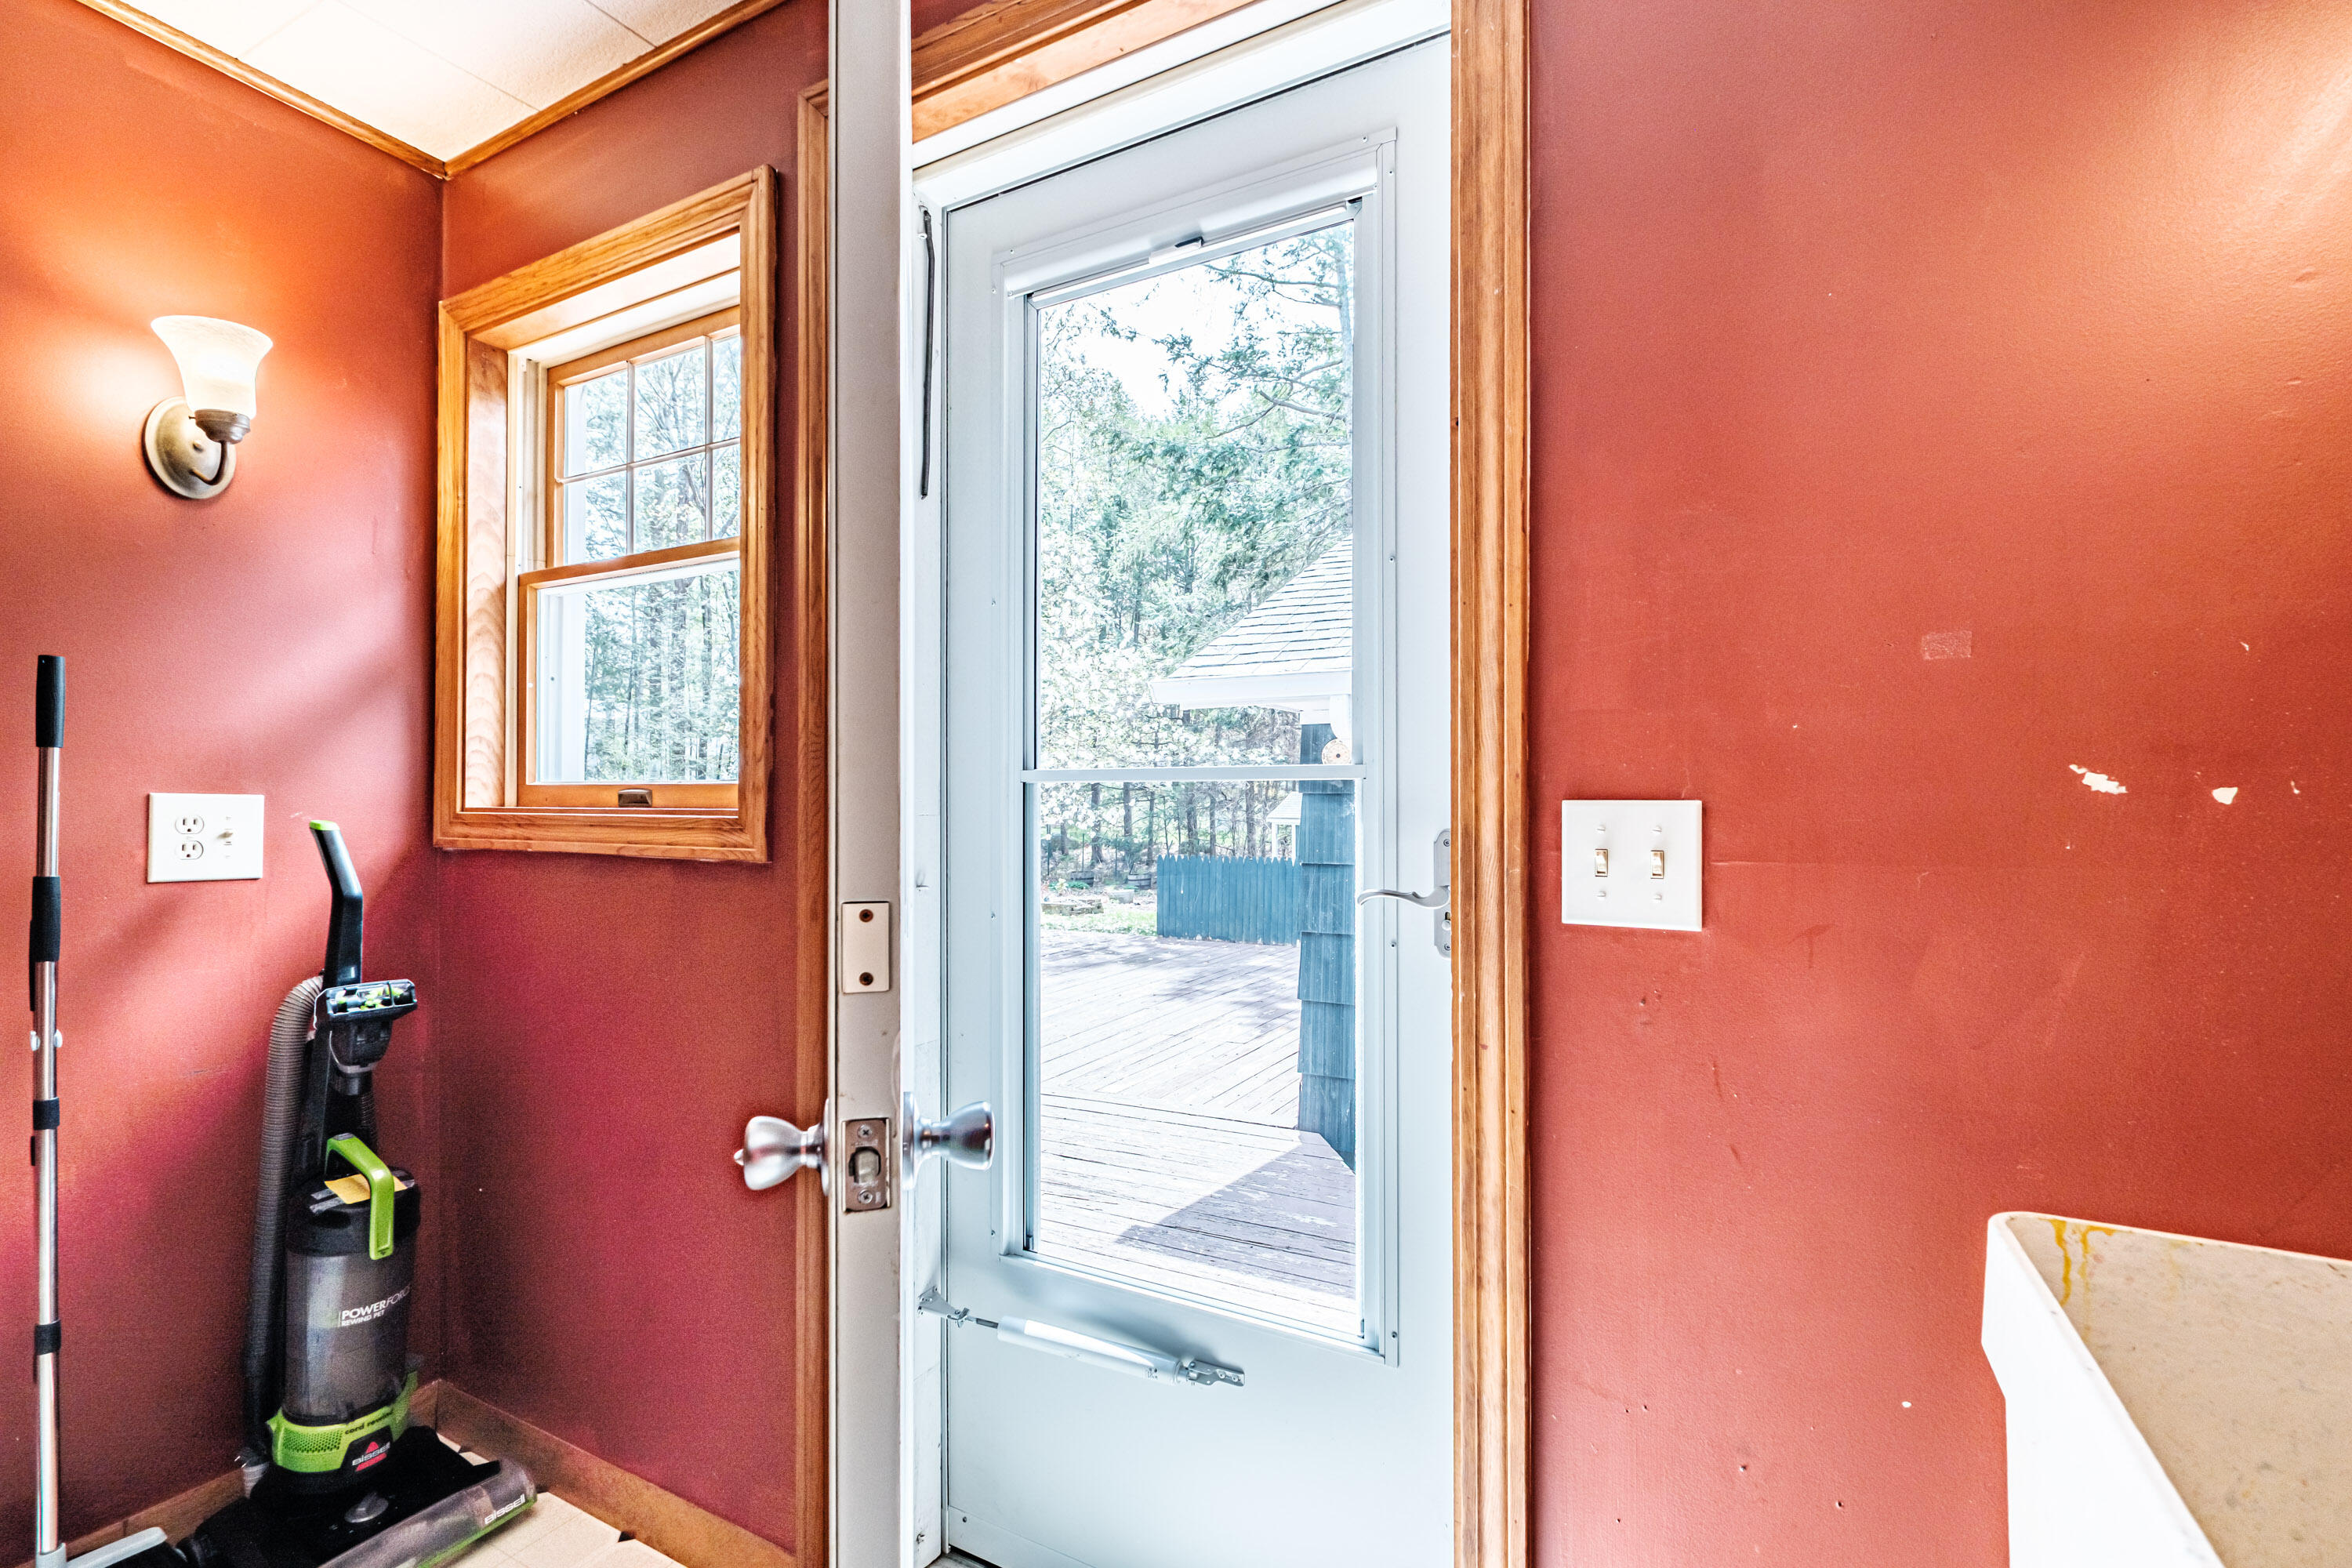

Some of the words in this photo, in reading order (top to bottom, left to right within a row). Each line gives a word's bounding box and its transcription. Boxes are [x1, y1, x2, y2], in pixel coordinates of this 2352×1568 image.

[341, 1315, 372, 1327] REWIND
[373, 1309, 386, 1319] PET
[345, 1422, 365, 1435] cord
